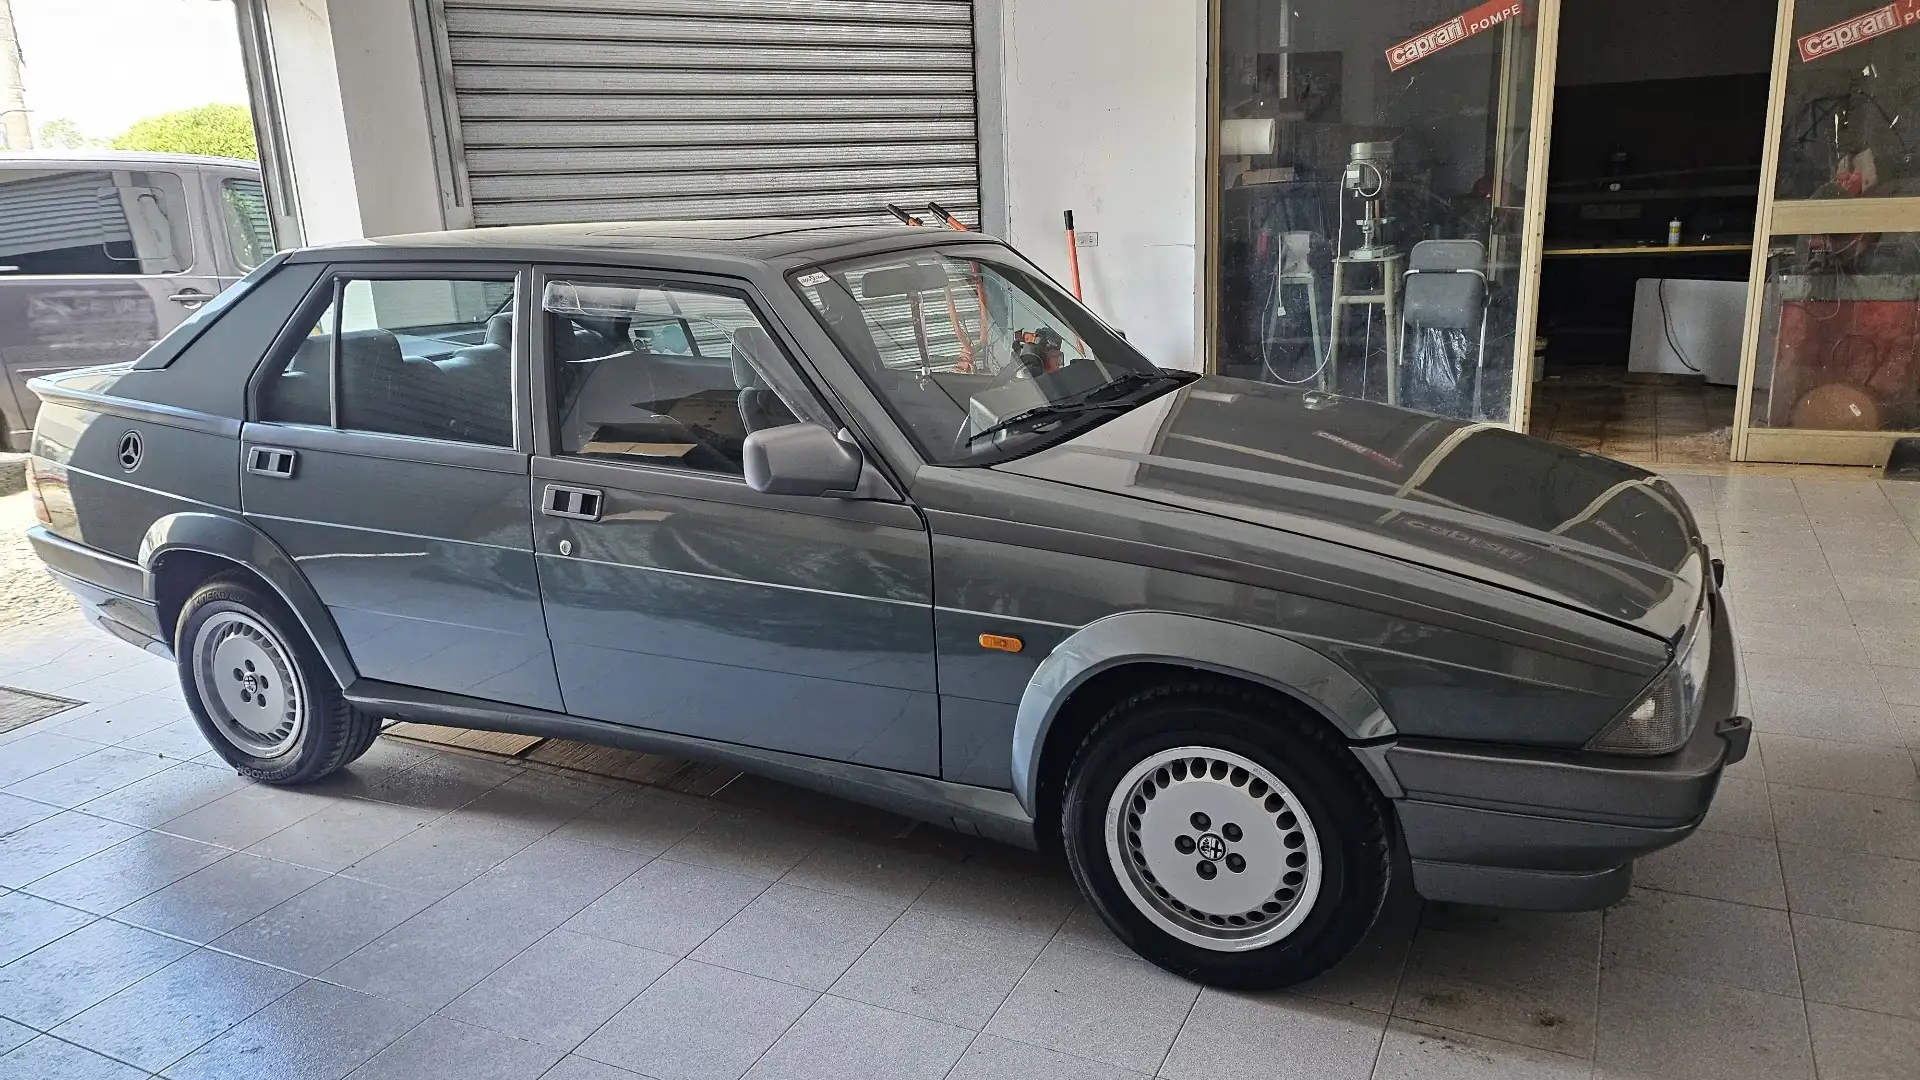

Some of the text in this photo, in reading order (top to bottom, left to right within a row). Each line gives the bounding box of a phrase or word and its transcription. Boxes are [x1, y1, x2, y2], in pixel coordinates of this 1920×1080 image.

[1392, 3, 1522, 64] caprari POMPE
[1805, 7, 1893, 55] caprari
